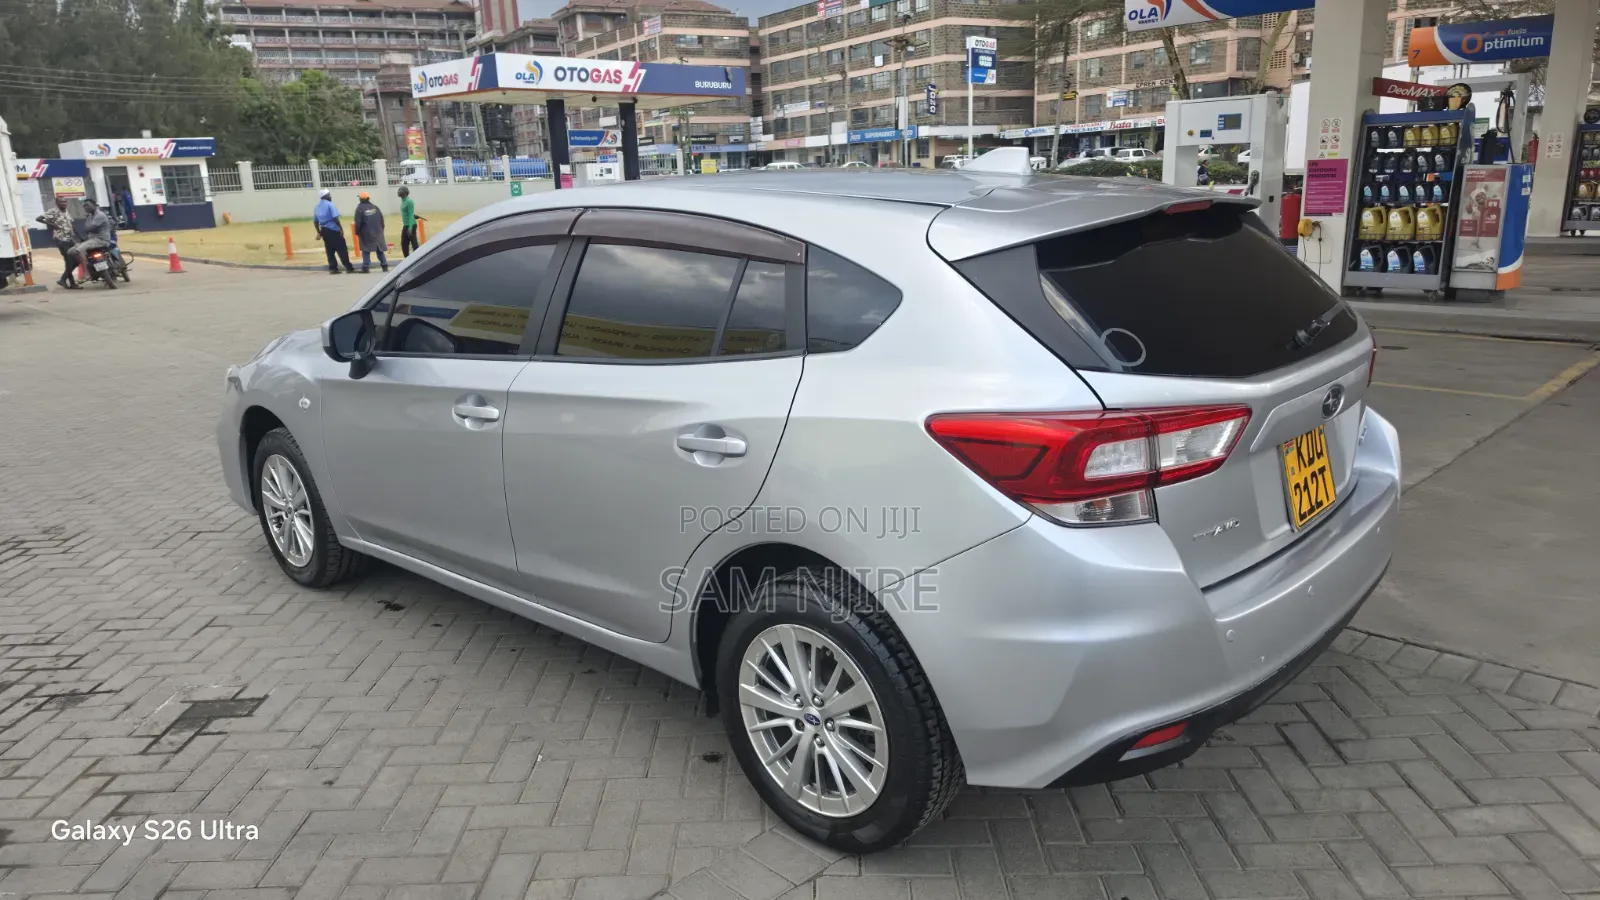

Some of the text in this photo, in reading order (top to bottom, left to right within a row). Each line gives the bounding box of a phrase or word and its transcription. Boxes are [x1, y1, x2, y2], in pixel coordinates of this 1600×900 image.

[1128, 7, 1158, 20] OLA
[1413, 50, 1420, 59] 7
[515, 72, 535, 80] OLA
[554, 66, 623, 84] OTOGAS
[429, 73, 459, 88] OTOGAS
[695, 80, 732, 89] BURUBURU
[1387, 85, 1440, 97] DeoMAX
[1109, 120, 1132, 129] Bata
[865, 131, 895, 139] SUPERMARKET
[1294, 465, 1330, 521] 212T
